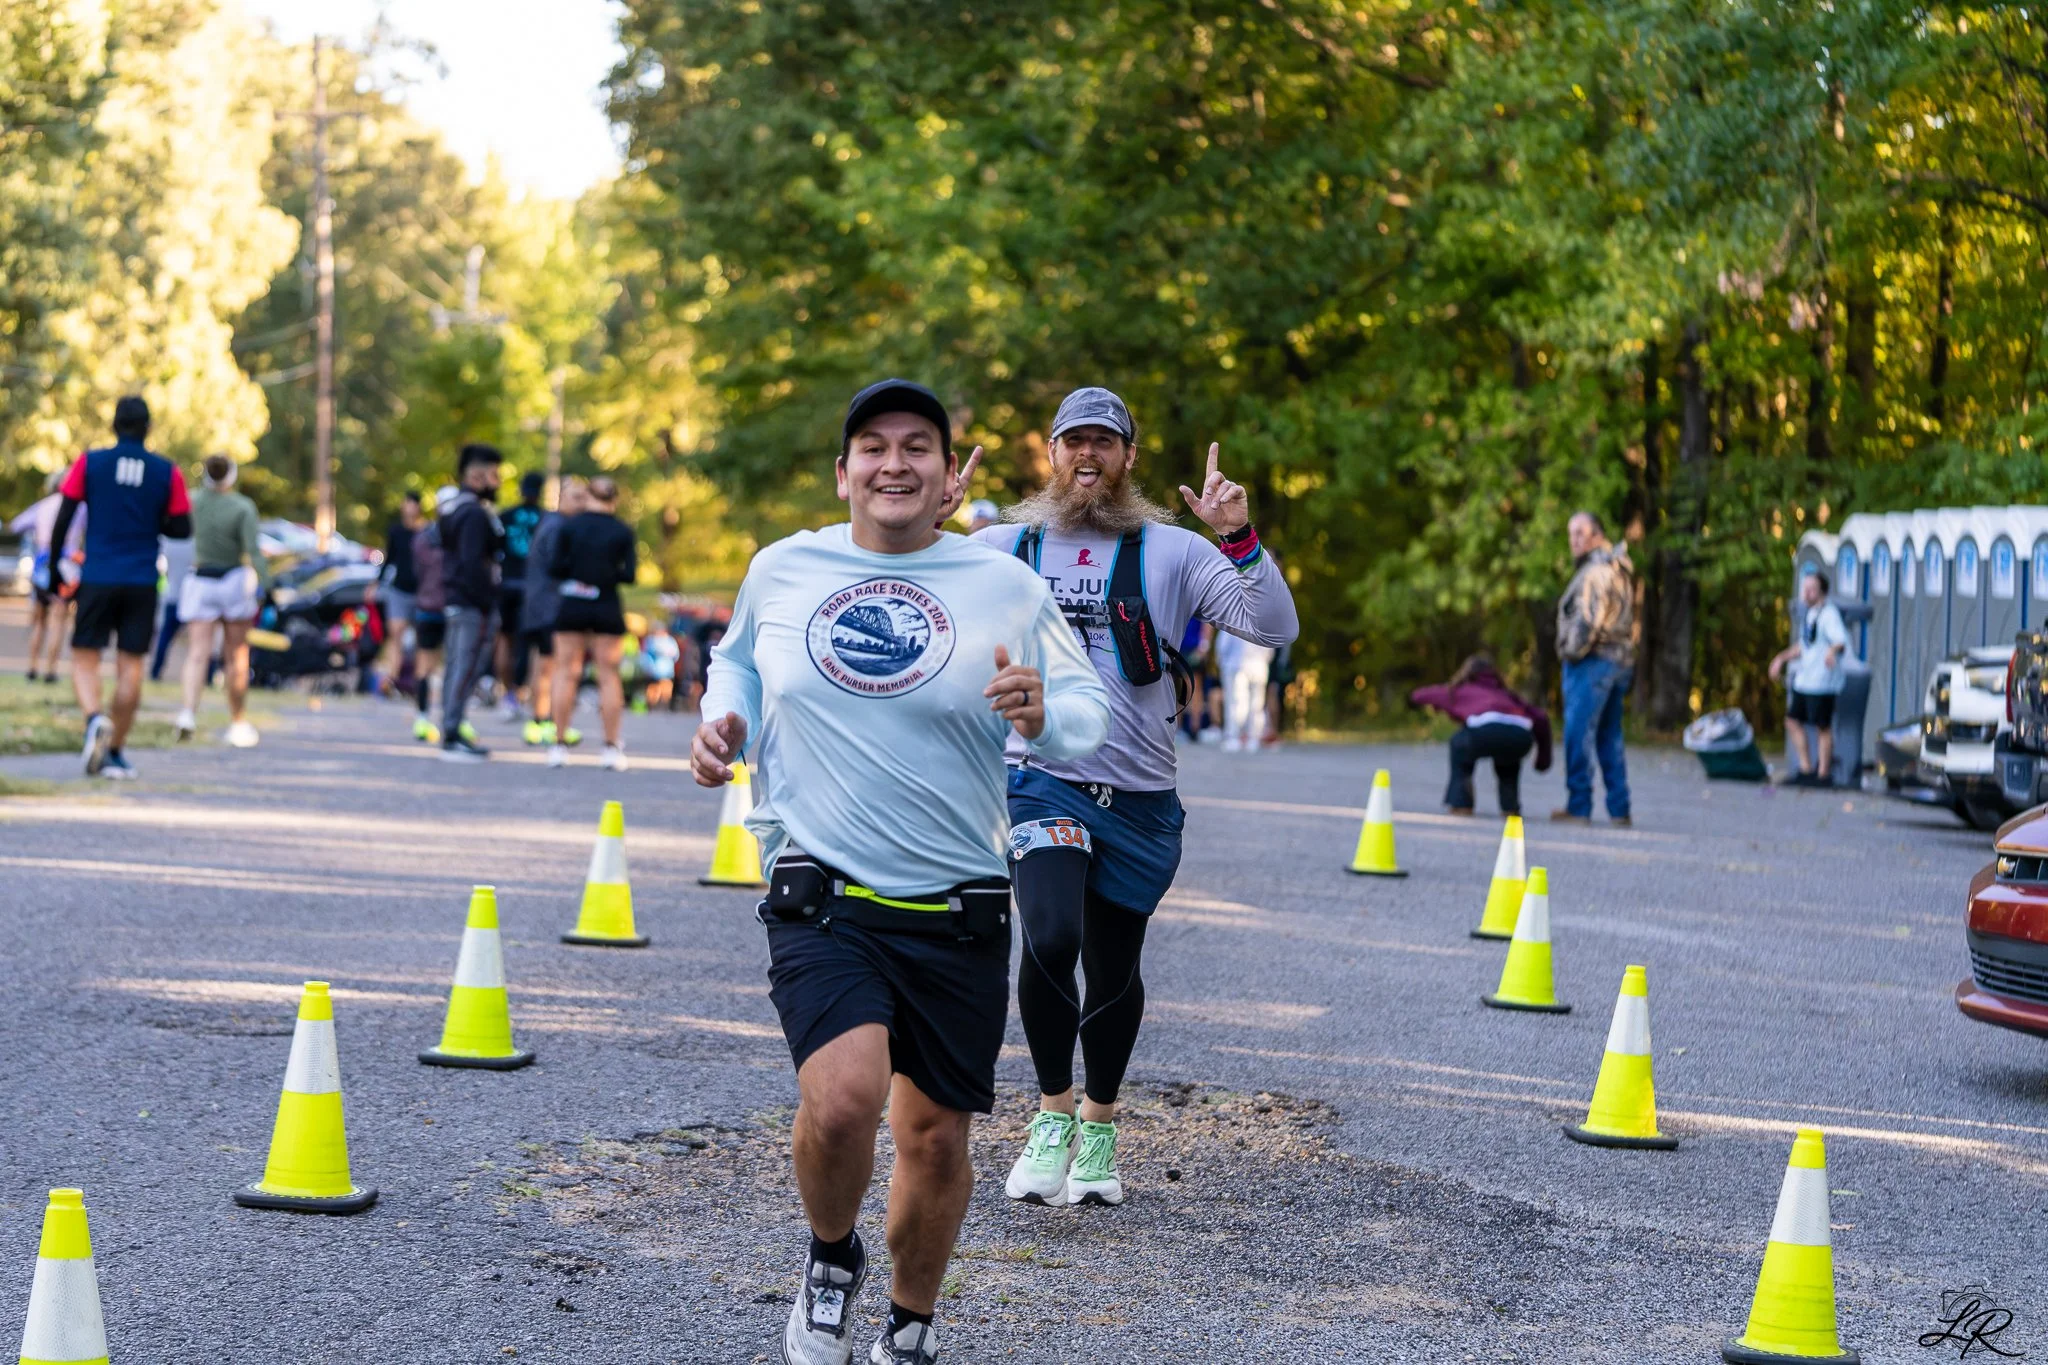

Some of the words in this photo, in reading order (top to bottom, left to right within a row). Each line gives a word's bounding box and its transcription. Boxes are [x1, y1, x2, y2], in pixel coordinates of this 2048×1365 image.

[1042, 576, 1064, 593] T.
[822, 593, 852, 618] ROAD
[855, 583, 887, 597] RACE
[890, 583, 931, 608] SERIES
[928, 604, 949, 632] 2026
[1140, 631, 1156, 672] NATHAN
[822, 657, 840, 678] LANE
[840, 674, 875, 692] PURSER
[876, 670, 924, 693] MEMORIAL
[1046, 826, 1085, 848] 134
